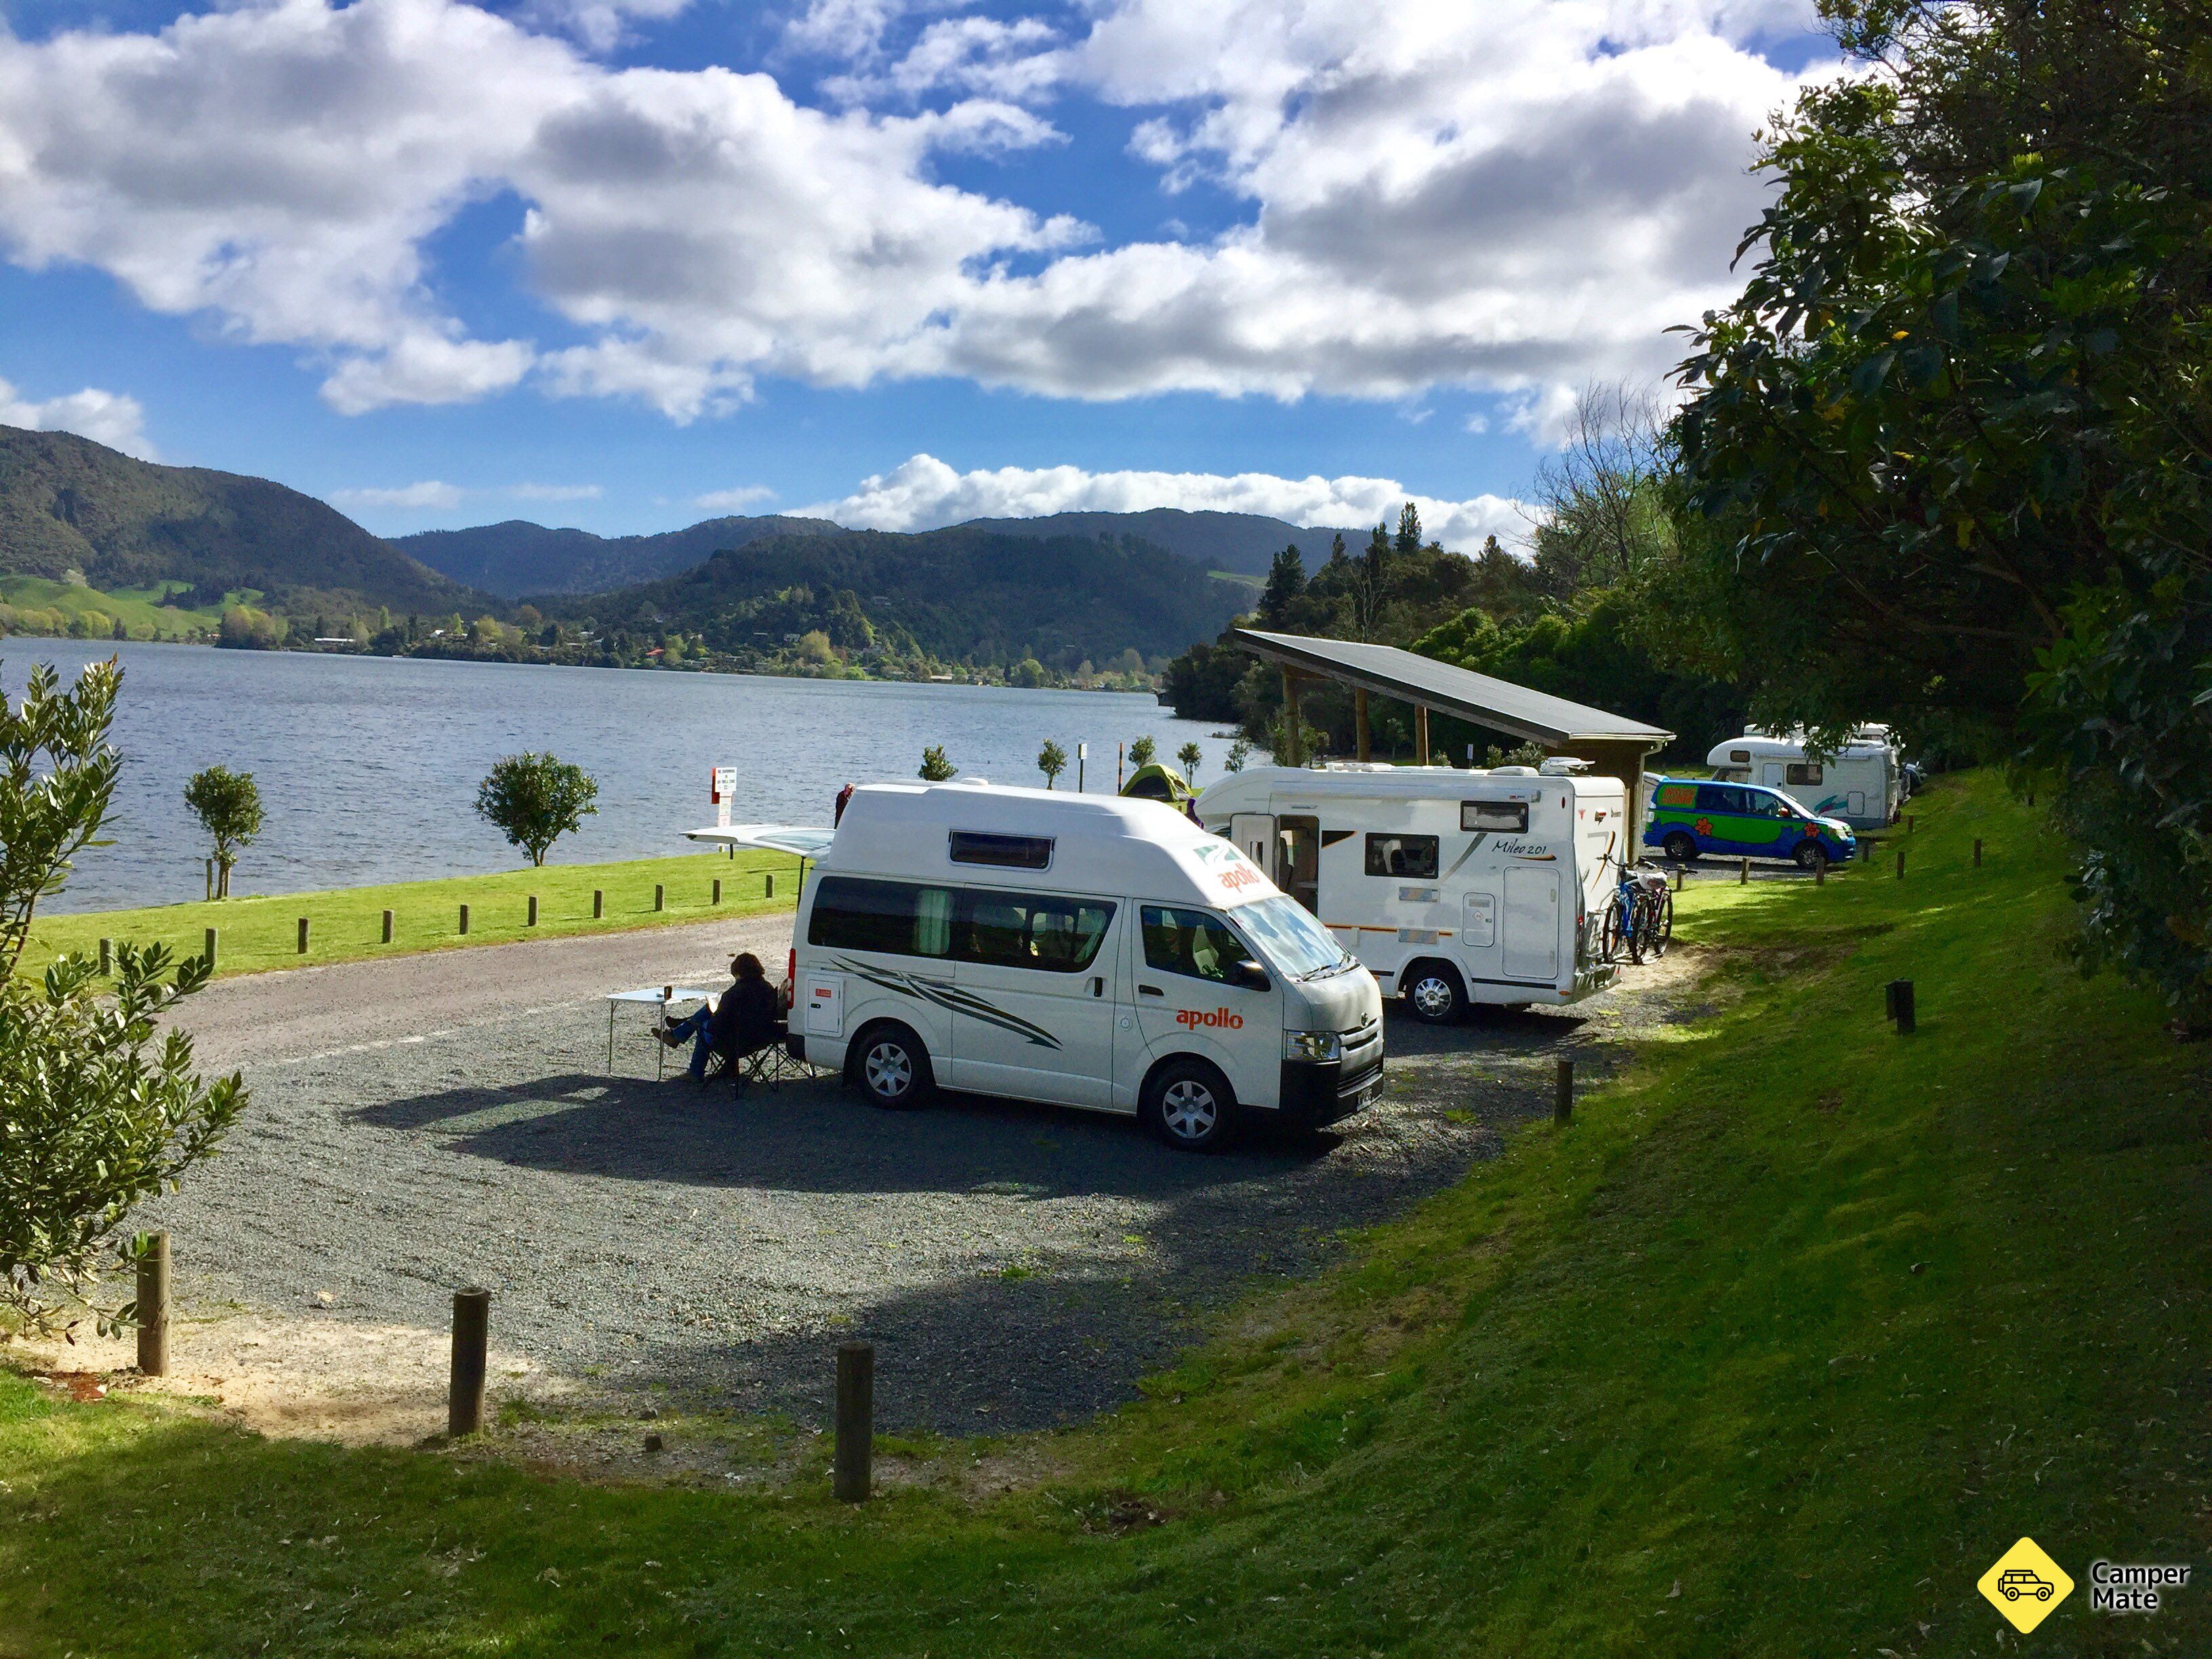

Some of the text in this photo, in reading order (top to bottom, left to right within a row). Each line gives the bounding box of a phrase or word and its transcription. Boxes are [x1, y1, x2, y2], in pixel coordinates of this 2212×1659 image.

[1491, 838, 1547, 855] Mileo 201
[1218, 863, 1260, 894] apollo
[1176, 1007, 1244, 1030] apollo
